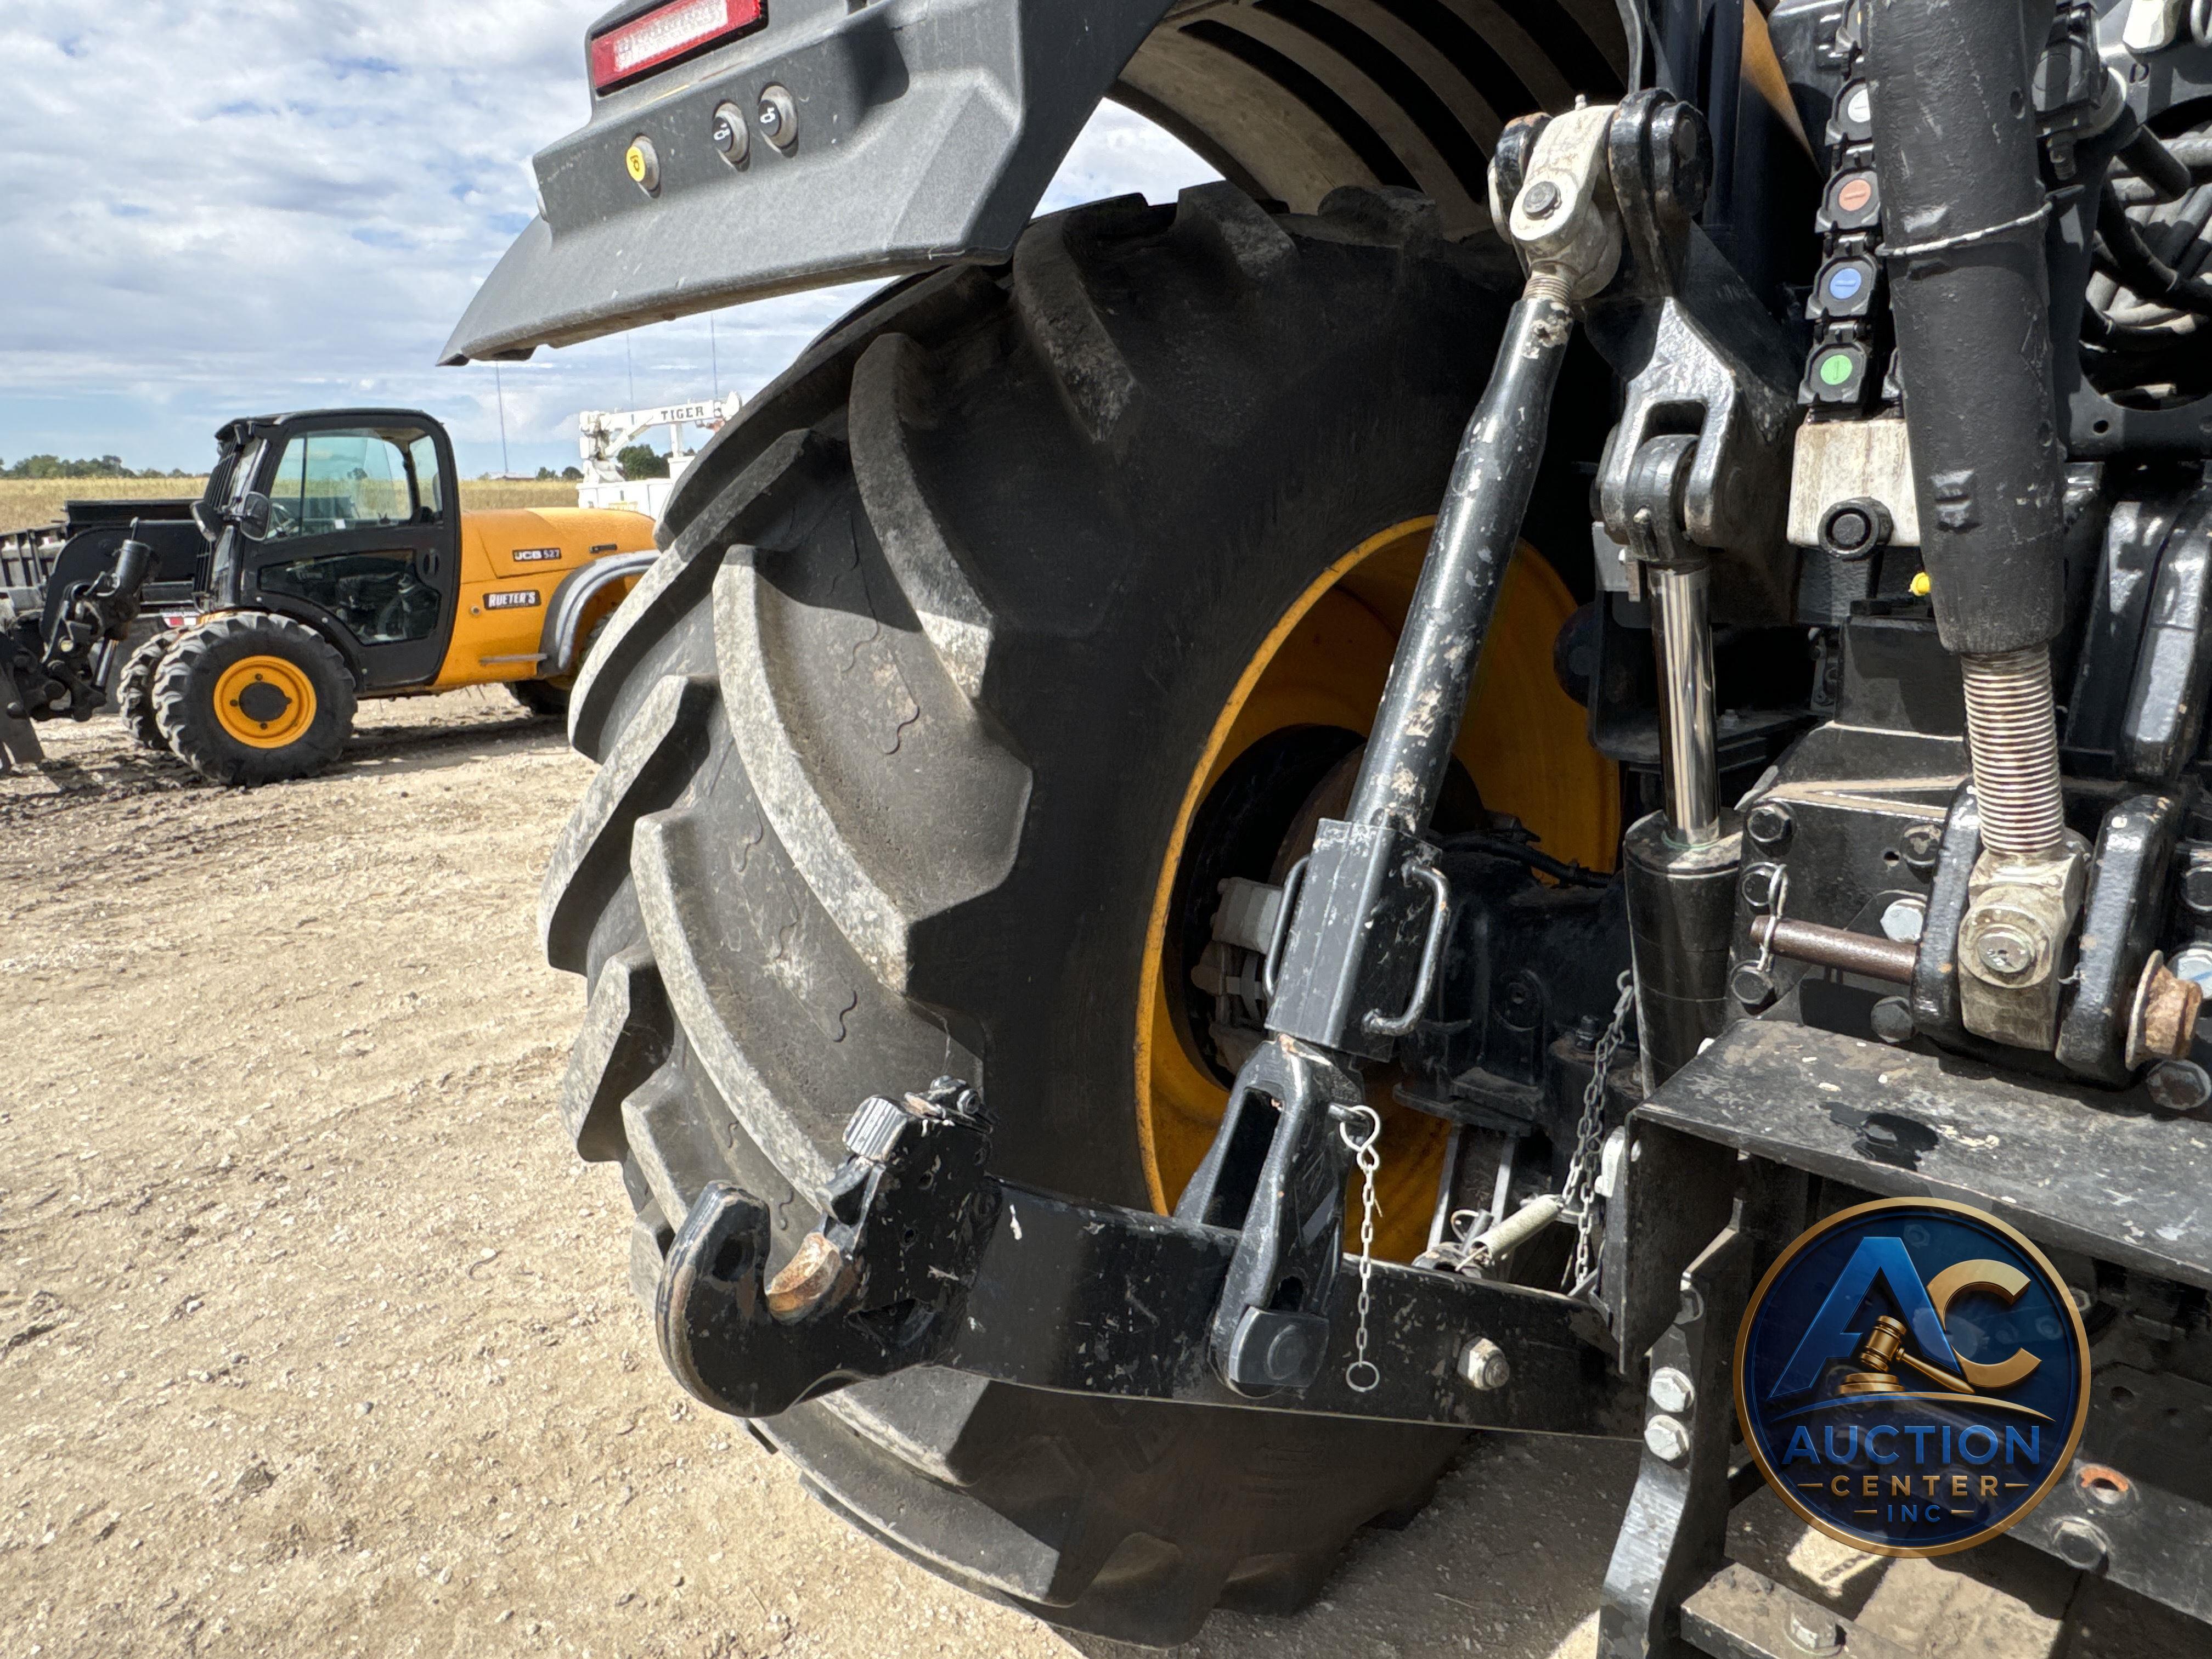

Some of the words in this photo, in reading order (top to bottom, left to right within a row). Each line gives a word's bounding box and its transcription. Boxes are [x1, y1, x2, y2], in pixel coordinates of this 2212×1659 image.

[661, 406, 704, 421] TIGER
[514, 551, 541, 560] JCB
[543, 549, 560, 558] 527
[488, 591, 535, 607] RUETER'S
